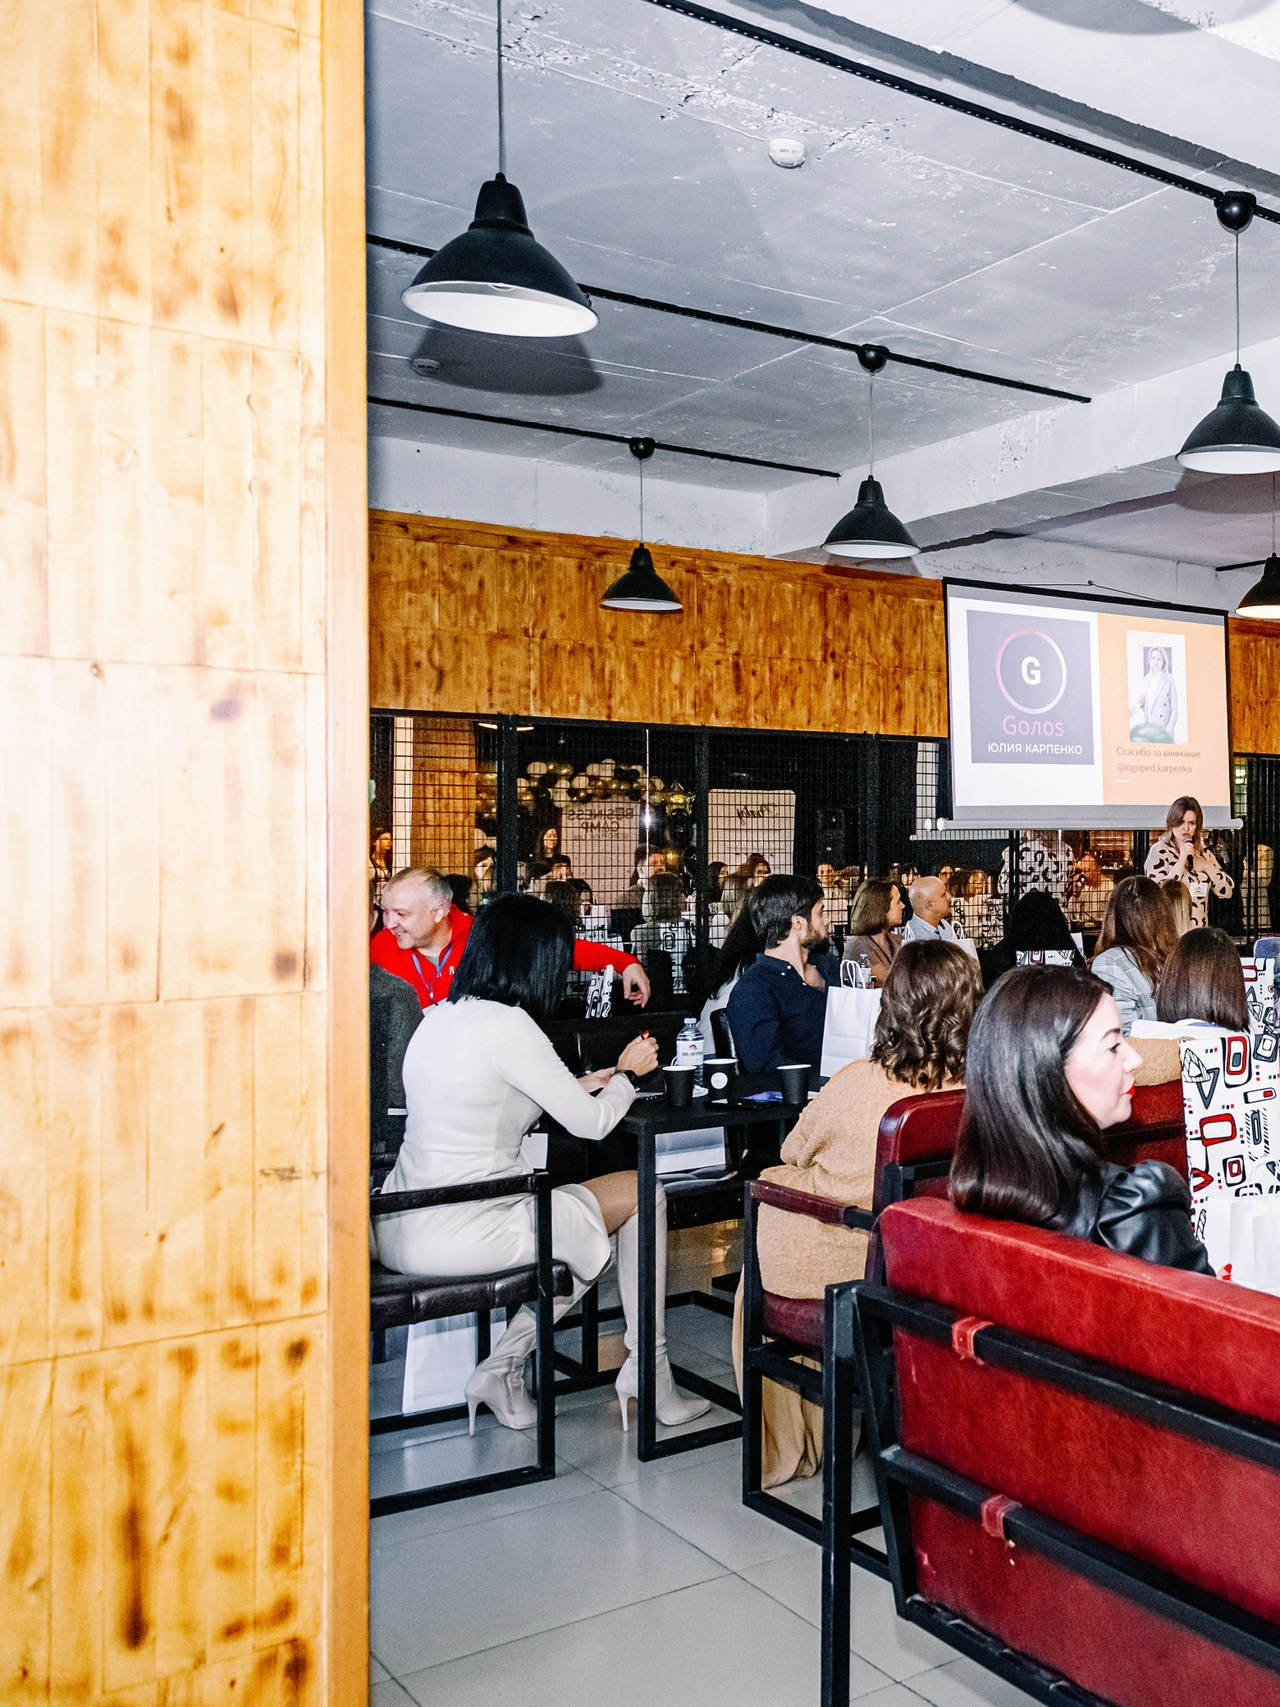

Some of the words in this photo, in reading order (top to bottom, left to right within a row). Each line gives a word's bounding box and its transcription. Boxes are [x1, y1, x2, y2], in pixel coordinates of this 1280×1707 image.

[1020, 656, 1042, 686] G
[988, 742, 1022, 753] ЮЛИЯ
[1025, 743, 1083, 755] КАРПЕНКО
[1116, 746, 1151, 757] Спасибо
[1164, 750, 1202, 758] внимание
[1116, 762, 1193, 774] @logoped.karpenko
